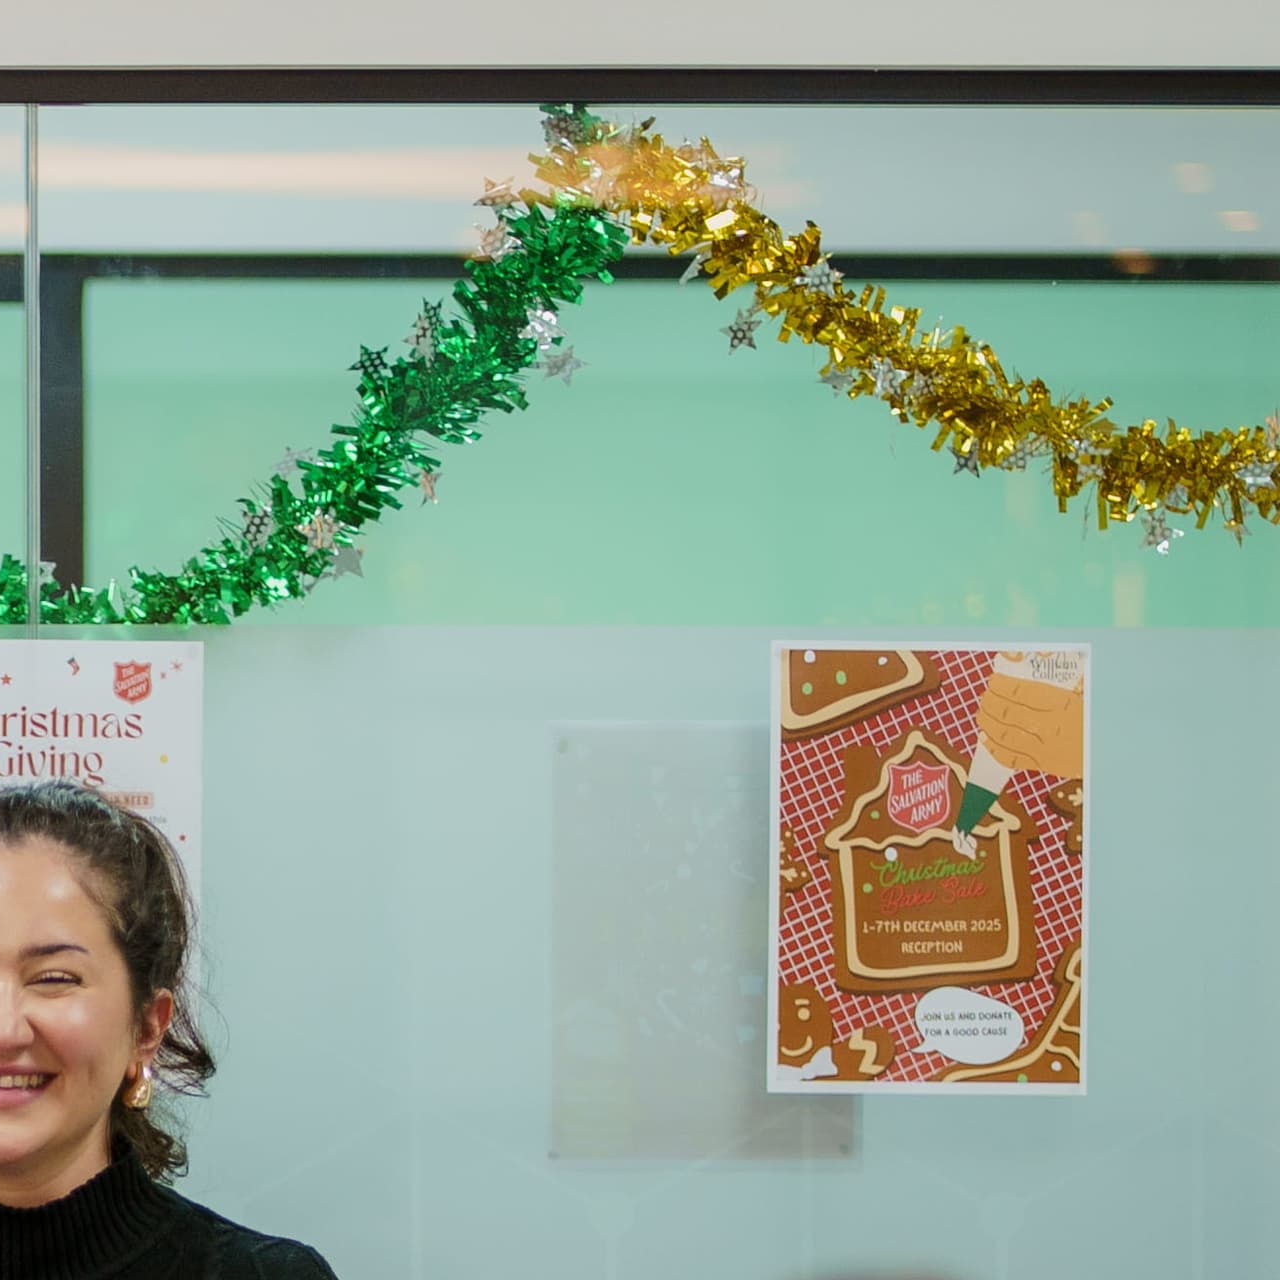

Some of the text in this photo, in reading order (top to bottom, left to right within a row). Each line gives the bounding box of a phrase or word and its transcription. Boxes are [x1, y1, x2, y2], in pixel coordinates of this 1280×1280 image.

[901, 769, 923, 789] THE
[891, 774, 945, 814] SALVATION
[910, 794, 943, 824] ARMY
[870, 858, 985, 887] Christmas
[880, 876, 986, 915] Bake Sale
[862, 918, 1002, 933] 1-7TH DECEMBER 2025
[901, 939, 963, 954] RECEPTION
[921, 1011, 1013, 1022] JOIN US AND DONATE
[925, 1028, 942, 1037] FOR
[953, 1028, 980, 1036] GOOD
[981, 1027, 1008, 1036] CAUSE
